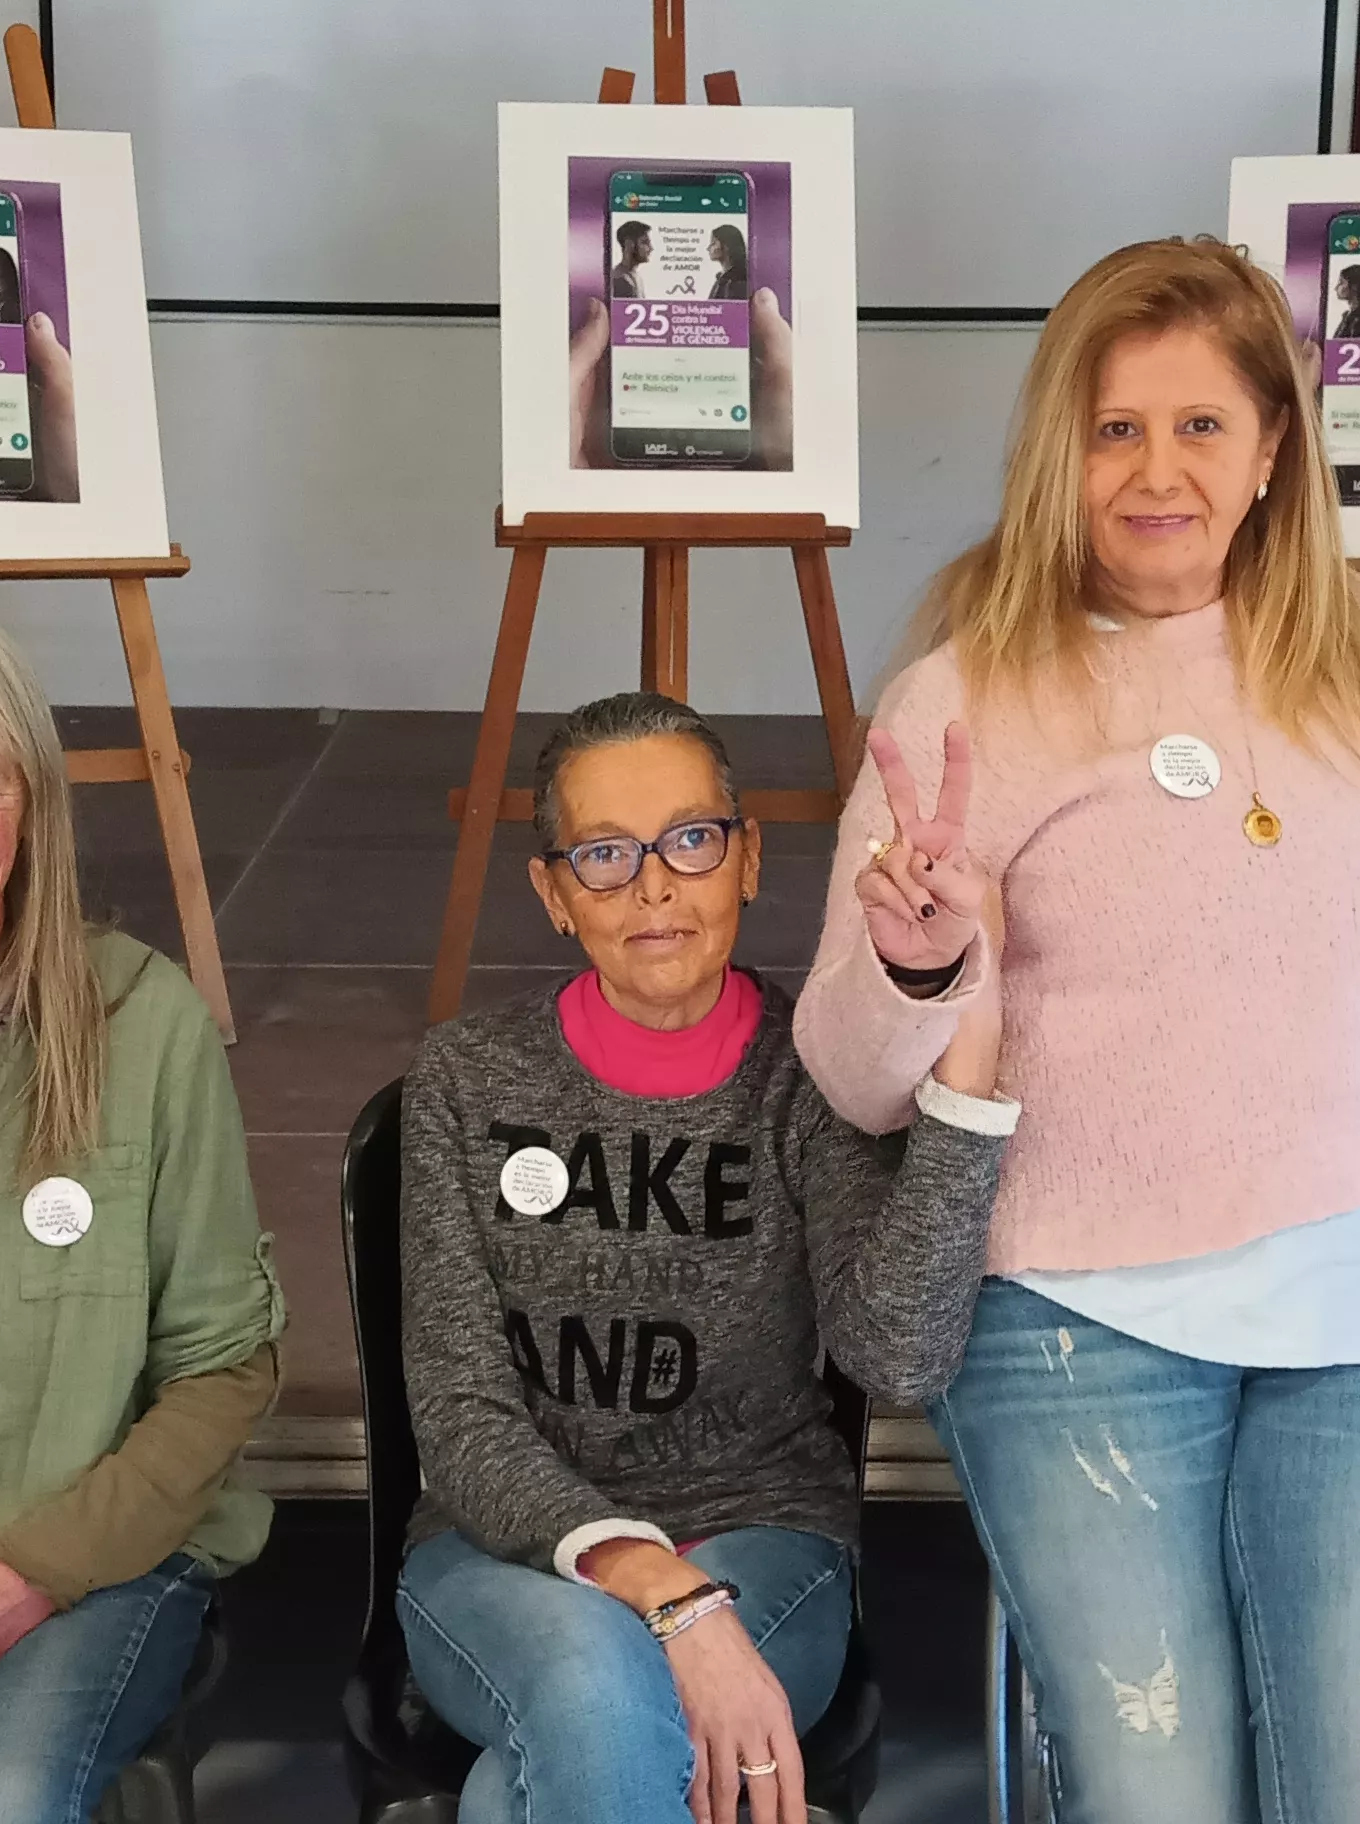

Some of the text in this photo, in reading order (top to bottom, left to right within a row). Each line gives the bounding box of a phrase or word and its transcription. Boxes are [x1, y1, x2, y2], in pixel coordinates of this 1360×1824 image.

[687, 305, 722, 314] Mundial
[624, 303, 669, 336] 25
[671, 315, 707, 324] contra la
[672, 325, 726, 335] VIOLENCIA
[672, 335, 686, 344] DE
[687, 334, 729, 344] GÉNERO
[622, 372, 643, 381] Ante
[488, 1121, 754, 1240] TAKE
[579, 1249, 704, 1293] HAND
[506, 1308, 698, 1414] AND
